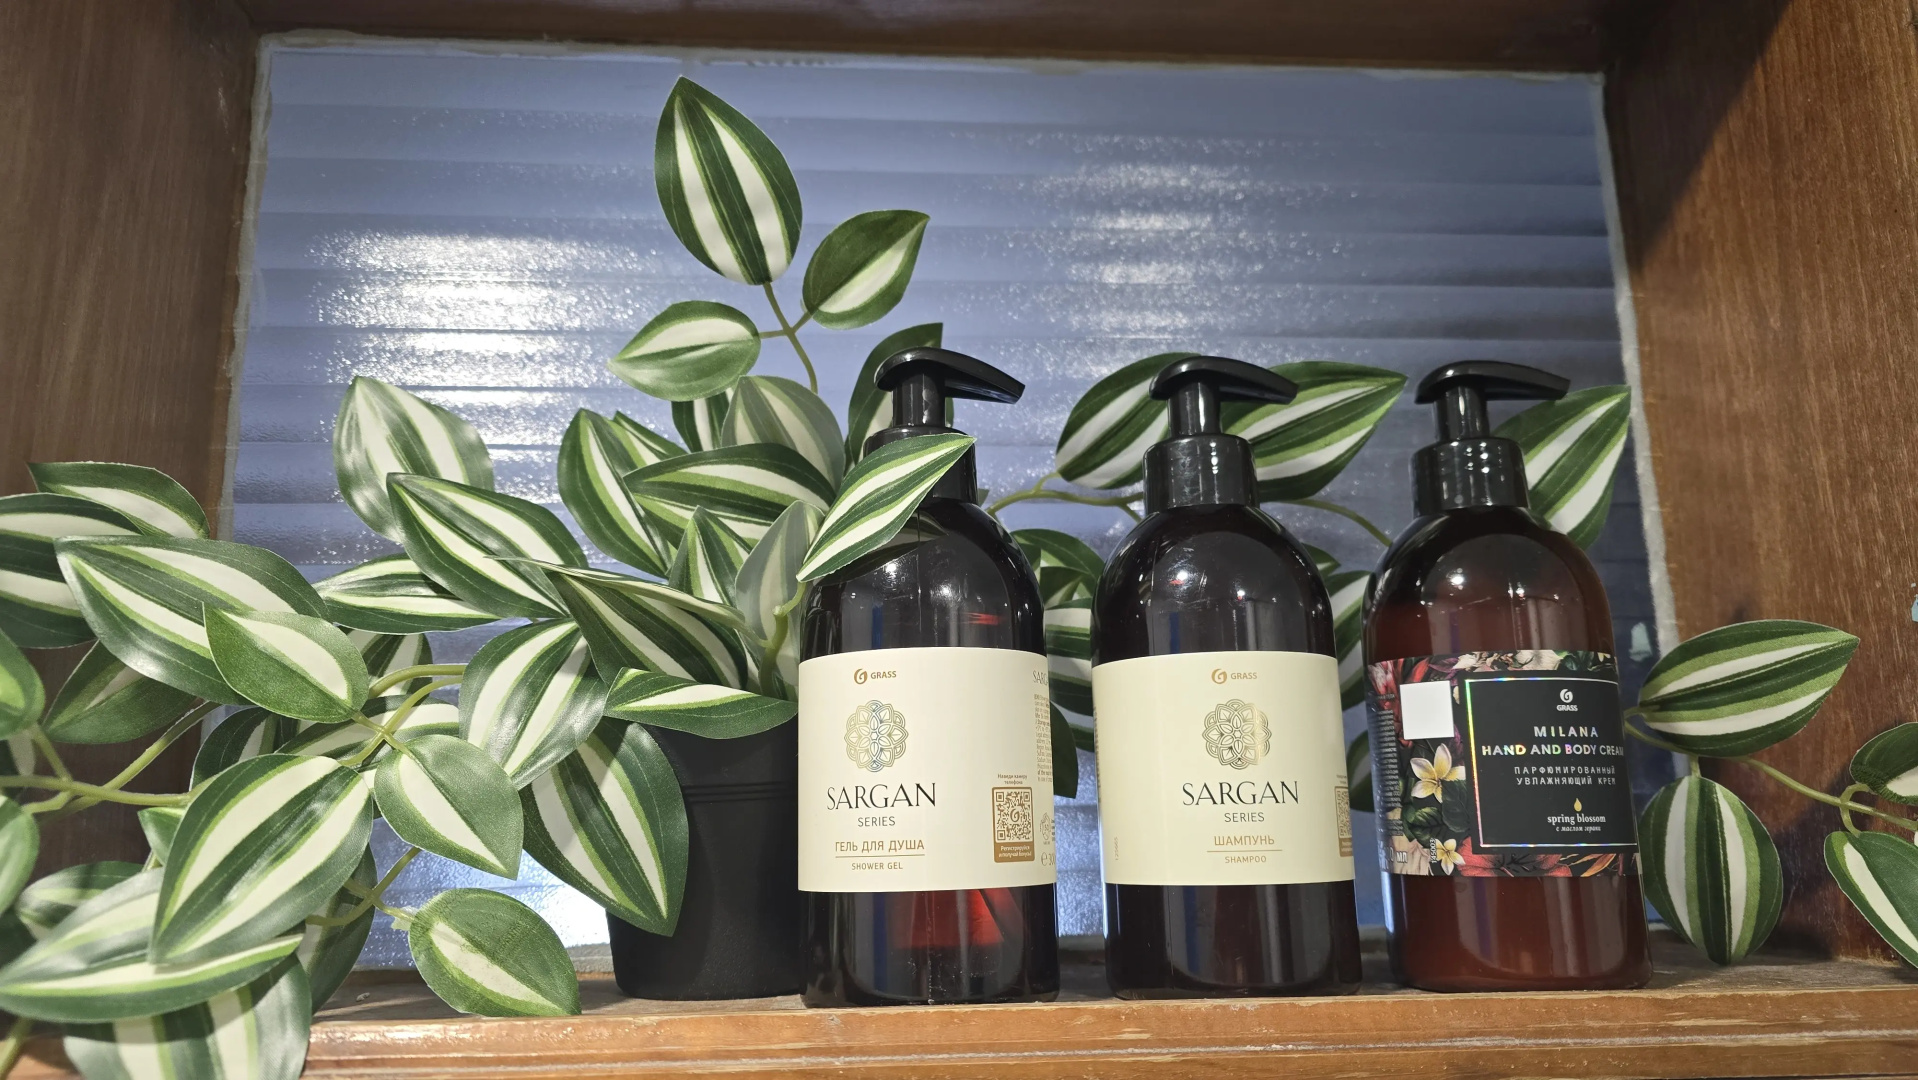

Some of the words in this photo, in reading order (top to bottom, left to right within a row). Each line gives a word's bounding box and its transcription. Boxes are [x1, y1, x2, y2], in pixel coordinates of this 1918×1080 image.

[870, 670, 897, 680] GRASS
[1230, 672, 1258, 680] GRASS
[1556, 704, 1578, 712] GRASS
[1533, 725, 1599, 738] MILANA
[1481, 744, 1527, 756] HAND
[1530, 744, 1562, 755] AND
[1564, 743, 1597, 756] BODY
[1599, 744, 1624, 757] CREAM
[1514, 765, 1616, 775] ПАРФЮМИРОВАННЫЙ
[1516, 775, 1593, 786] УВЛАЖНЯЮЩИЙ
[1597, 777, 1616, 786] КРЕМ
[826, 782, 936, 811] SARGAN
[1181, 780, 1299, 806] SARGAN
[857, 816, 896, 828] SERIES
[1224, 812, 1265, 823] SERIES
[1547, 813, 1576, 826] spring
[1576, 813, 1606, 823] blossom
[835, 841, 858, 852] ГЕЛЬ
[861, 840, 884, 853] ДЛЯ
[888, 839, 925, 853] ДУША
[1213, 835, 1275, 847] ШАМПУНЬ
[1224, 855, 1267, 864] SHAMPOO
[851, 862, 884, 871] SHOWER
[887, 861, 904, 870] GEL
